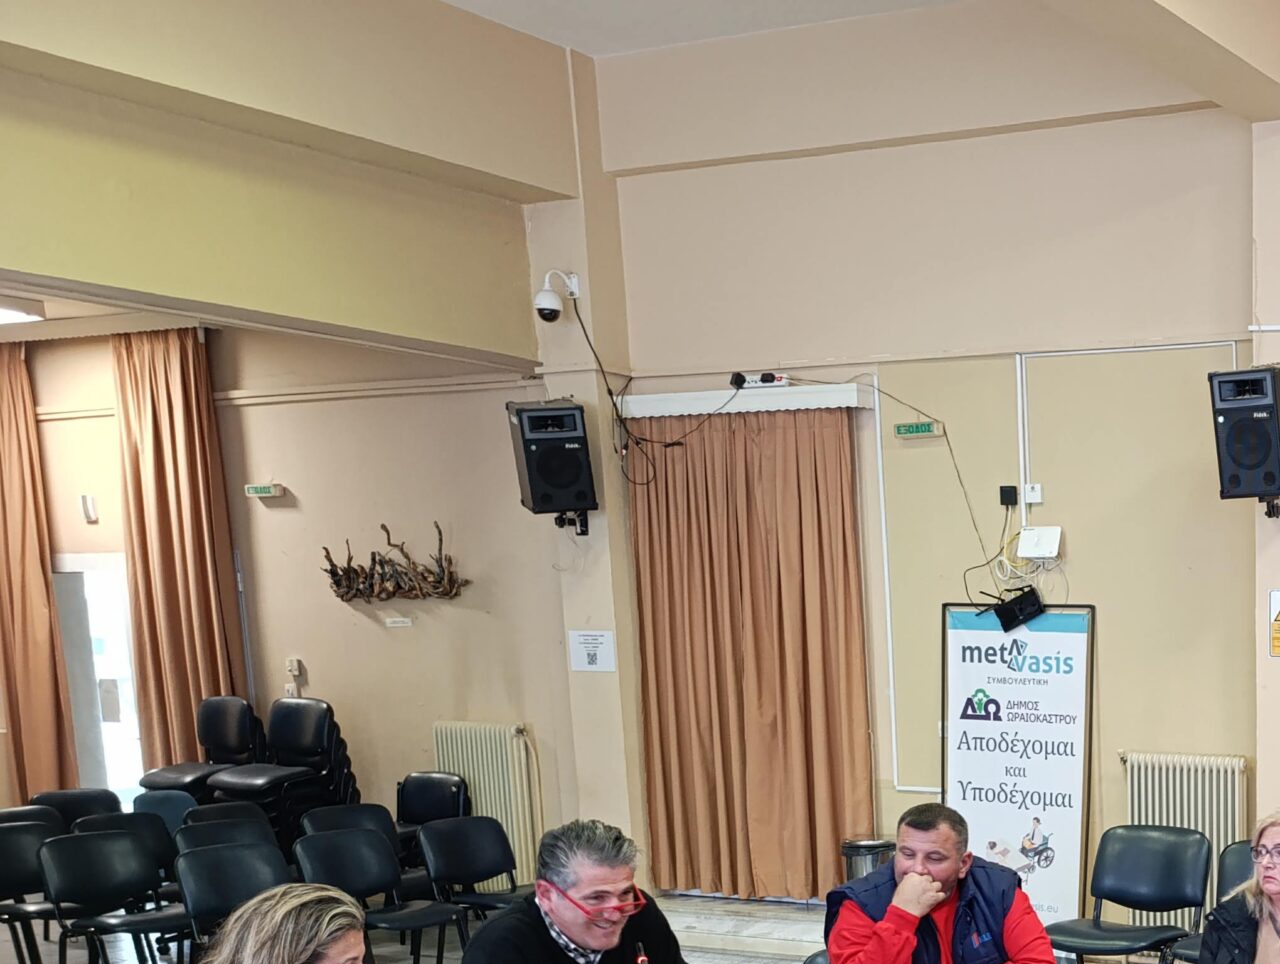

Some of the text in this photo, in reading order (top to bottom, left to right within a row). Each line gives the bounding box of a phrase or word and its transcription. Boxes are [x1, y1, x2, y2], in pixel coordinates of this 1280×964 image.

[987, 676, 1049, 685] ΣΥΜΒΟΥΛΕΥΤΙΚΗ
[1006, 700, 1040, 711] ΔΗΜΟΣ
[1006, 712, 1077, 724] ΩΡΑΙΟΚΑΣΤΡΟΥ
[957, 730, 1076, 760] Αποδέχομαι
[1005, 766, 1027, 778] και
[957, 780, 1074, 812] Υποδέχομαι
